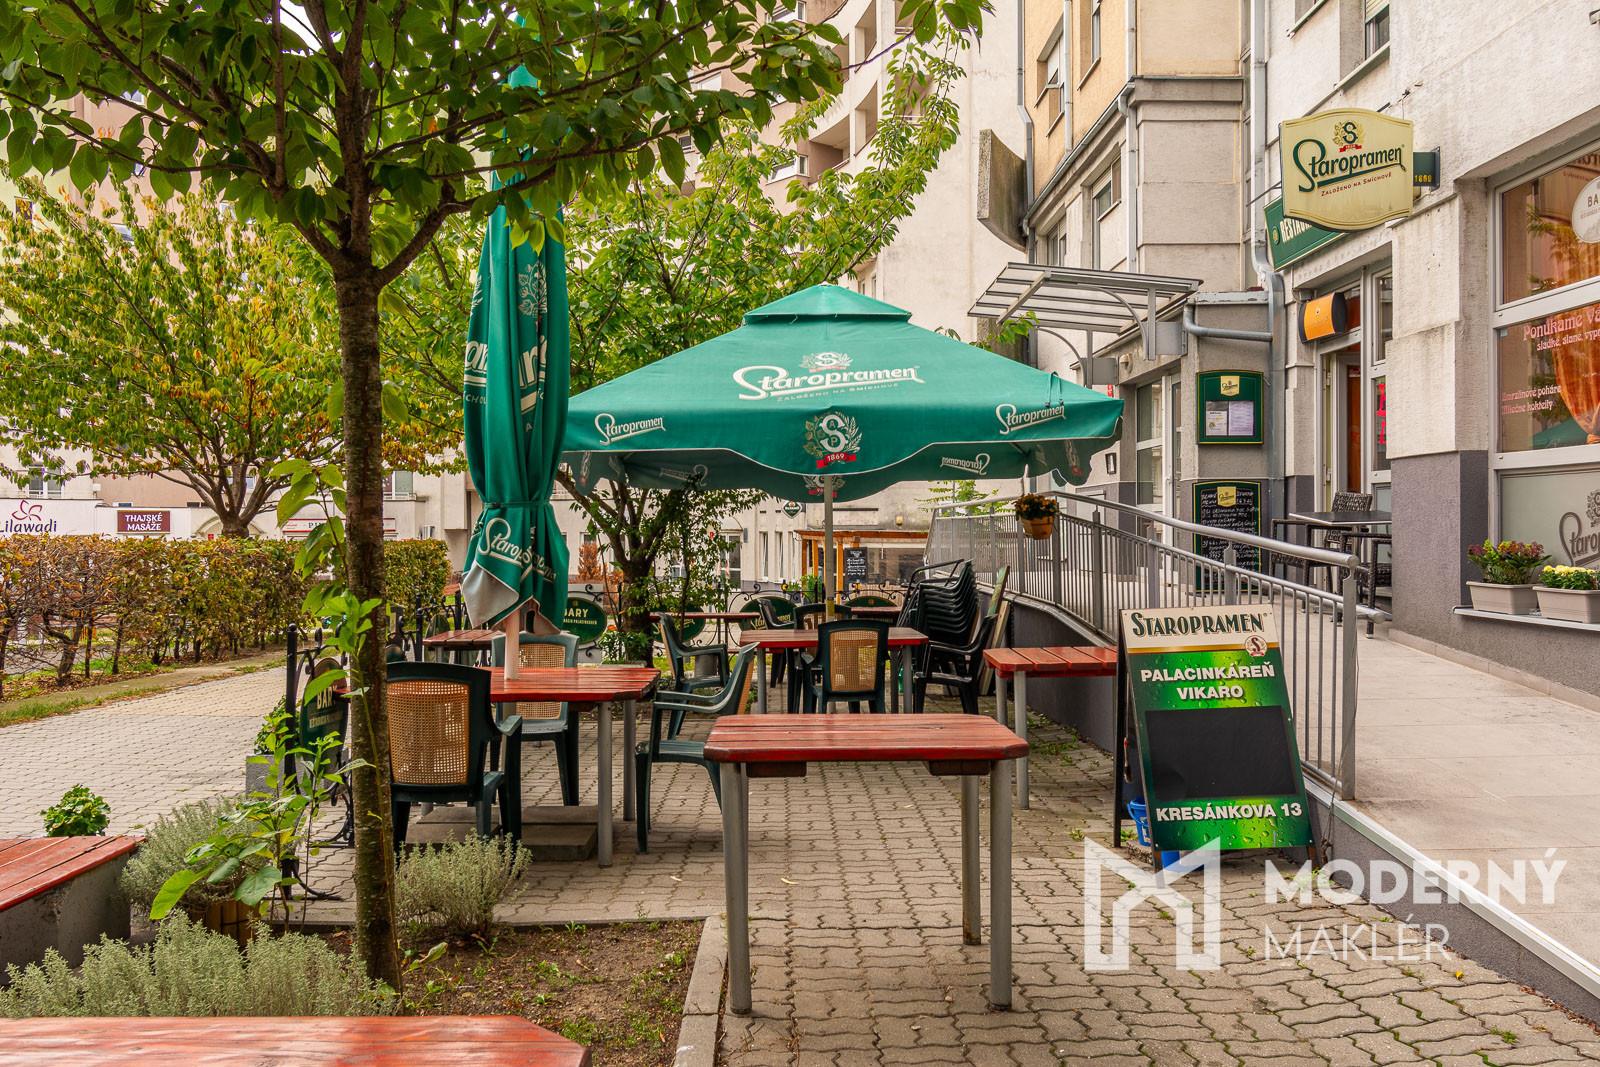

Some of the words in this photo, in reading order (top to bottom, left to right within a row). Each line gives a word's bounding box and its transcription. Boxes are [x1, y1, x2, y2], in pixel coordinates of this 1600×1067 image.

[1293, 138, 1404, 192] Staropramen
[733, 365, 925, 400] Staropramen
[595, 413, 666, 446] Staropramen
[996, 403, 1066, 435] Staropramen
[828, 453, 845, 461] 1869
[125, 512, 163, 522] THAJSKÉ
[127, 521, 161, 531] MASÁŽE
[1131, 612, 1265, 637] STAROPRAMEN
[1141, 661, 1275, 682] PALACINKÁREŇ
[1177, 685, 1244, 700] VIKARO
[1156, 803, 1276, 822] KRESÁNKOVA
[1281, 803, 1302, 817] 13
